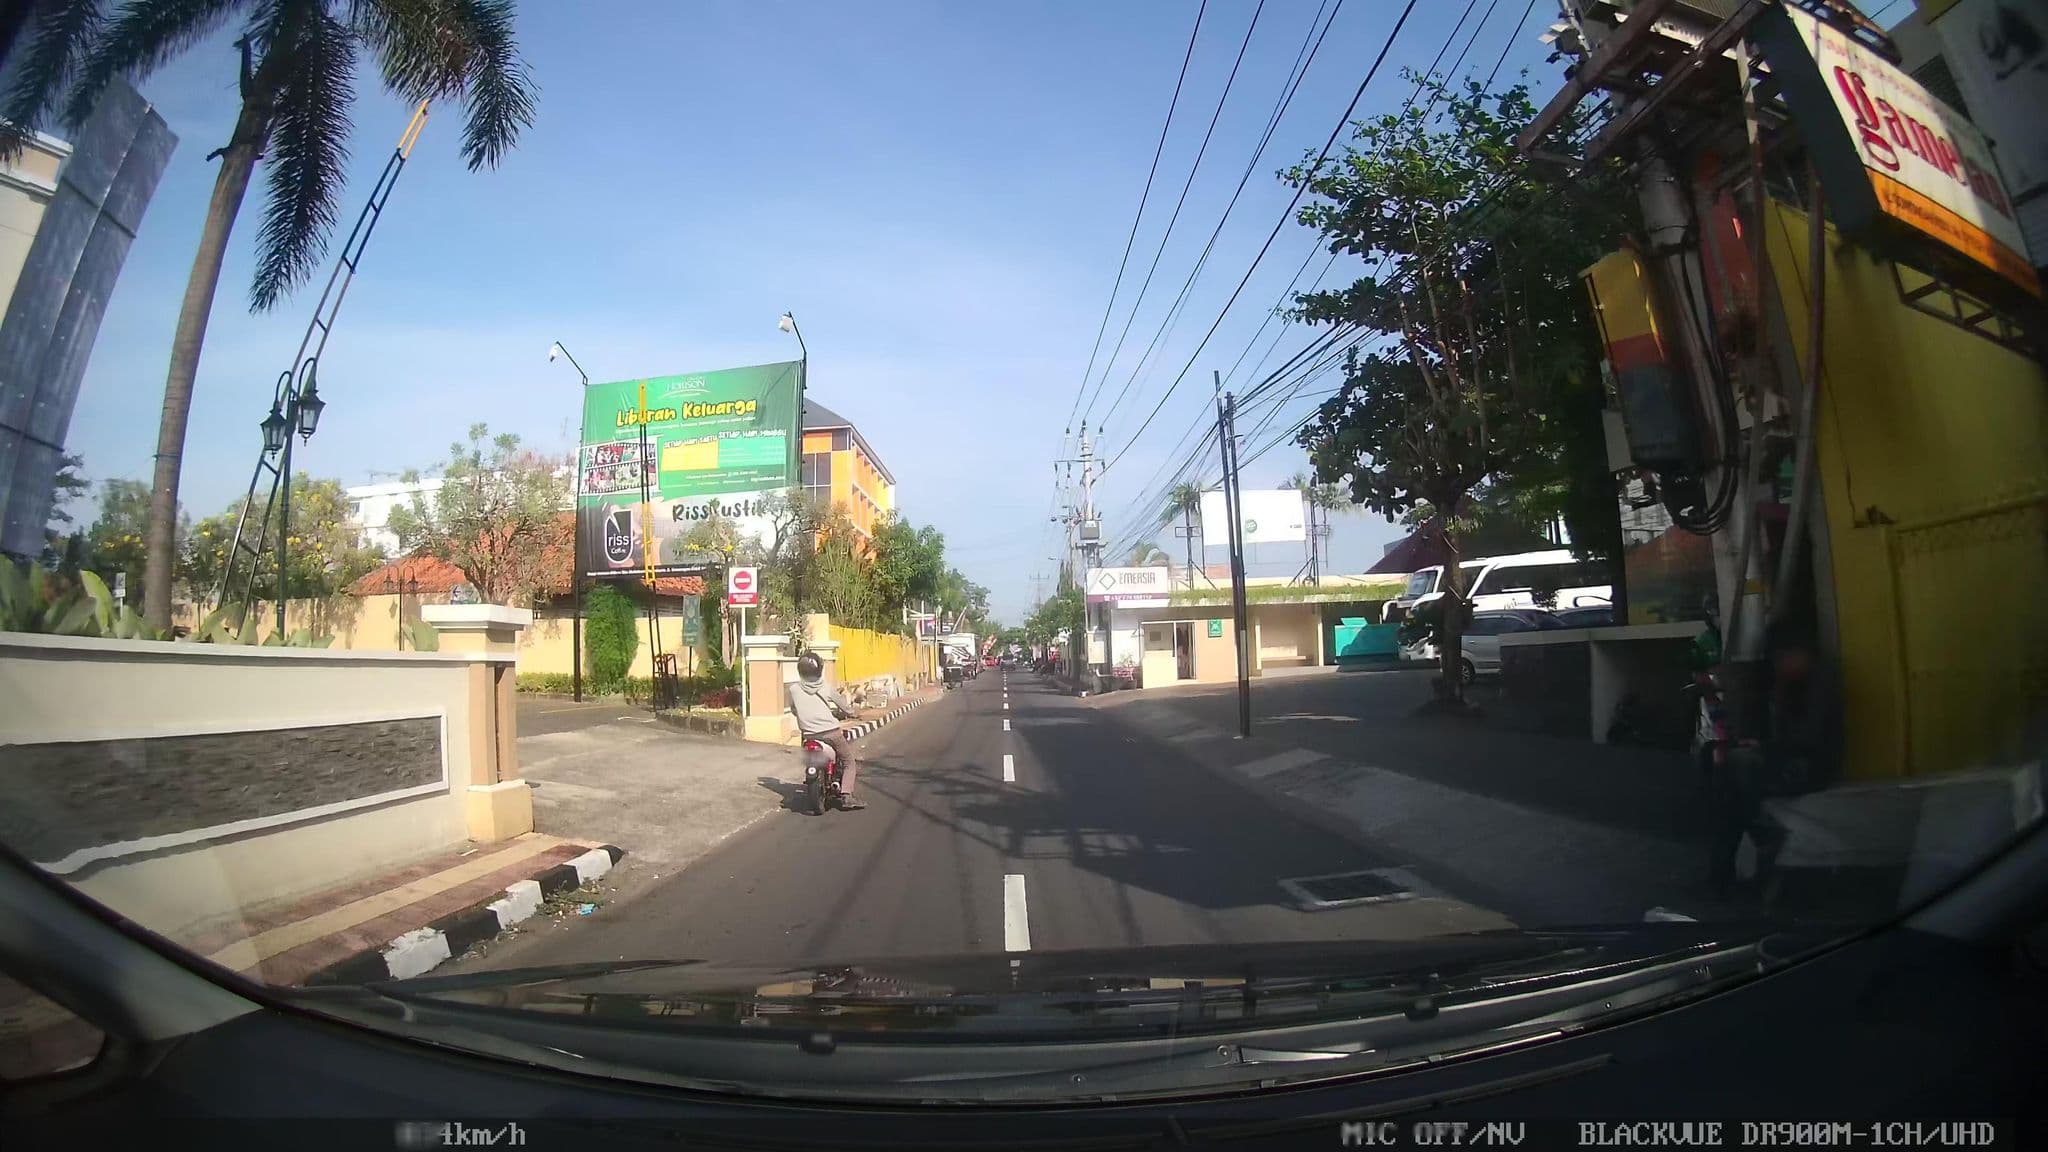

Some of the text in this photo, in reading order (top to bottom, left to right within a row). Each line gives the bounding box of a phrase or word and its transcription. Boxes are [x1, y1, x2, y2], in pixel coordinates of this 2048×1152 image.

[616, 407, 676, 427] Liburan
[682, 399, 757, 421] Keluarga
[608, 534, 630, 546] riss
